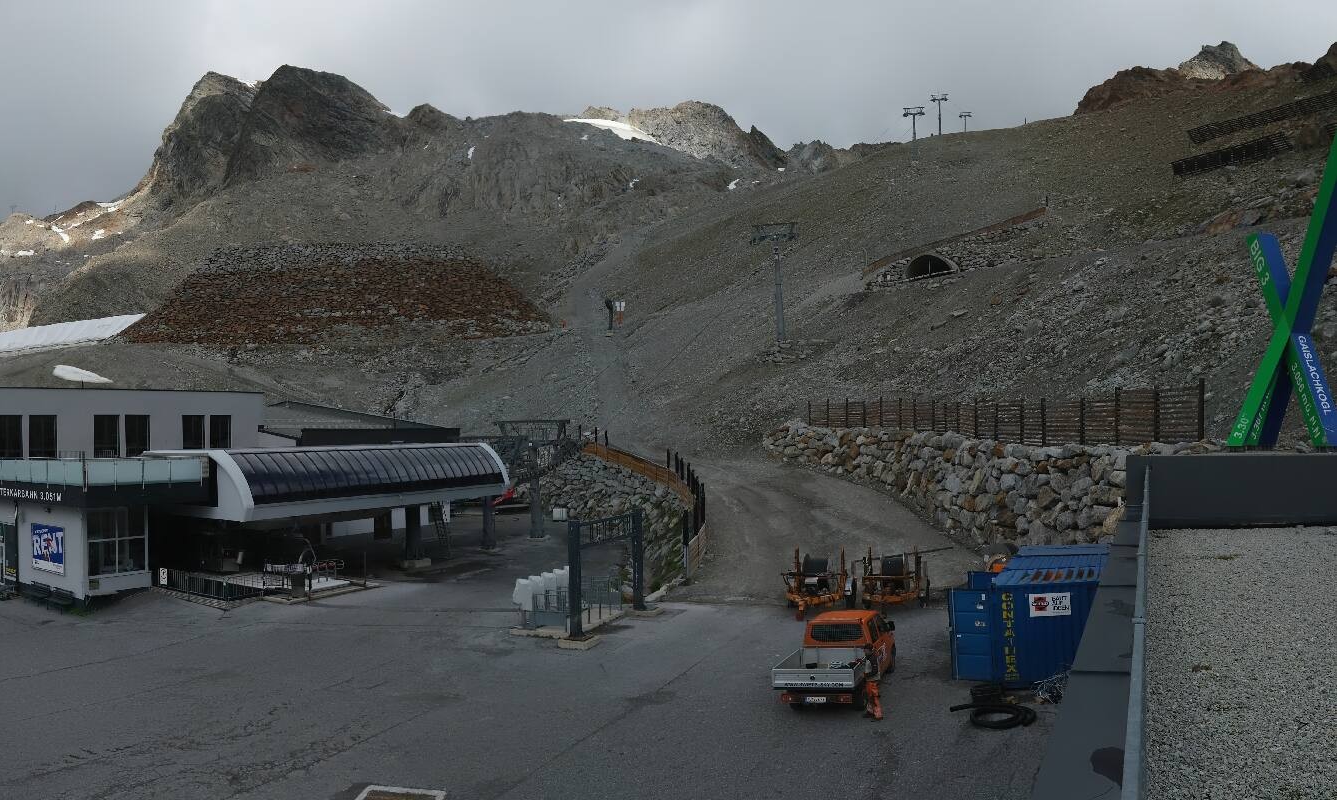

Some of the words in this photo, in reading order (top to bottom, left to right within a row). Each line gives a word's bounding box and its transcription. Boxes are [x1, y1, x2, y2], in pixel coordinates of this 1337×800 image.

[1250, 238, 1265, 272] BIG
[1261, 272, 1270, 285] 3
[1298, 335, 1332, 415] GAISLACHKOGL
[1234, 415, 1249, 439] 3.30
[32, 532, 64, 556] RENT
